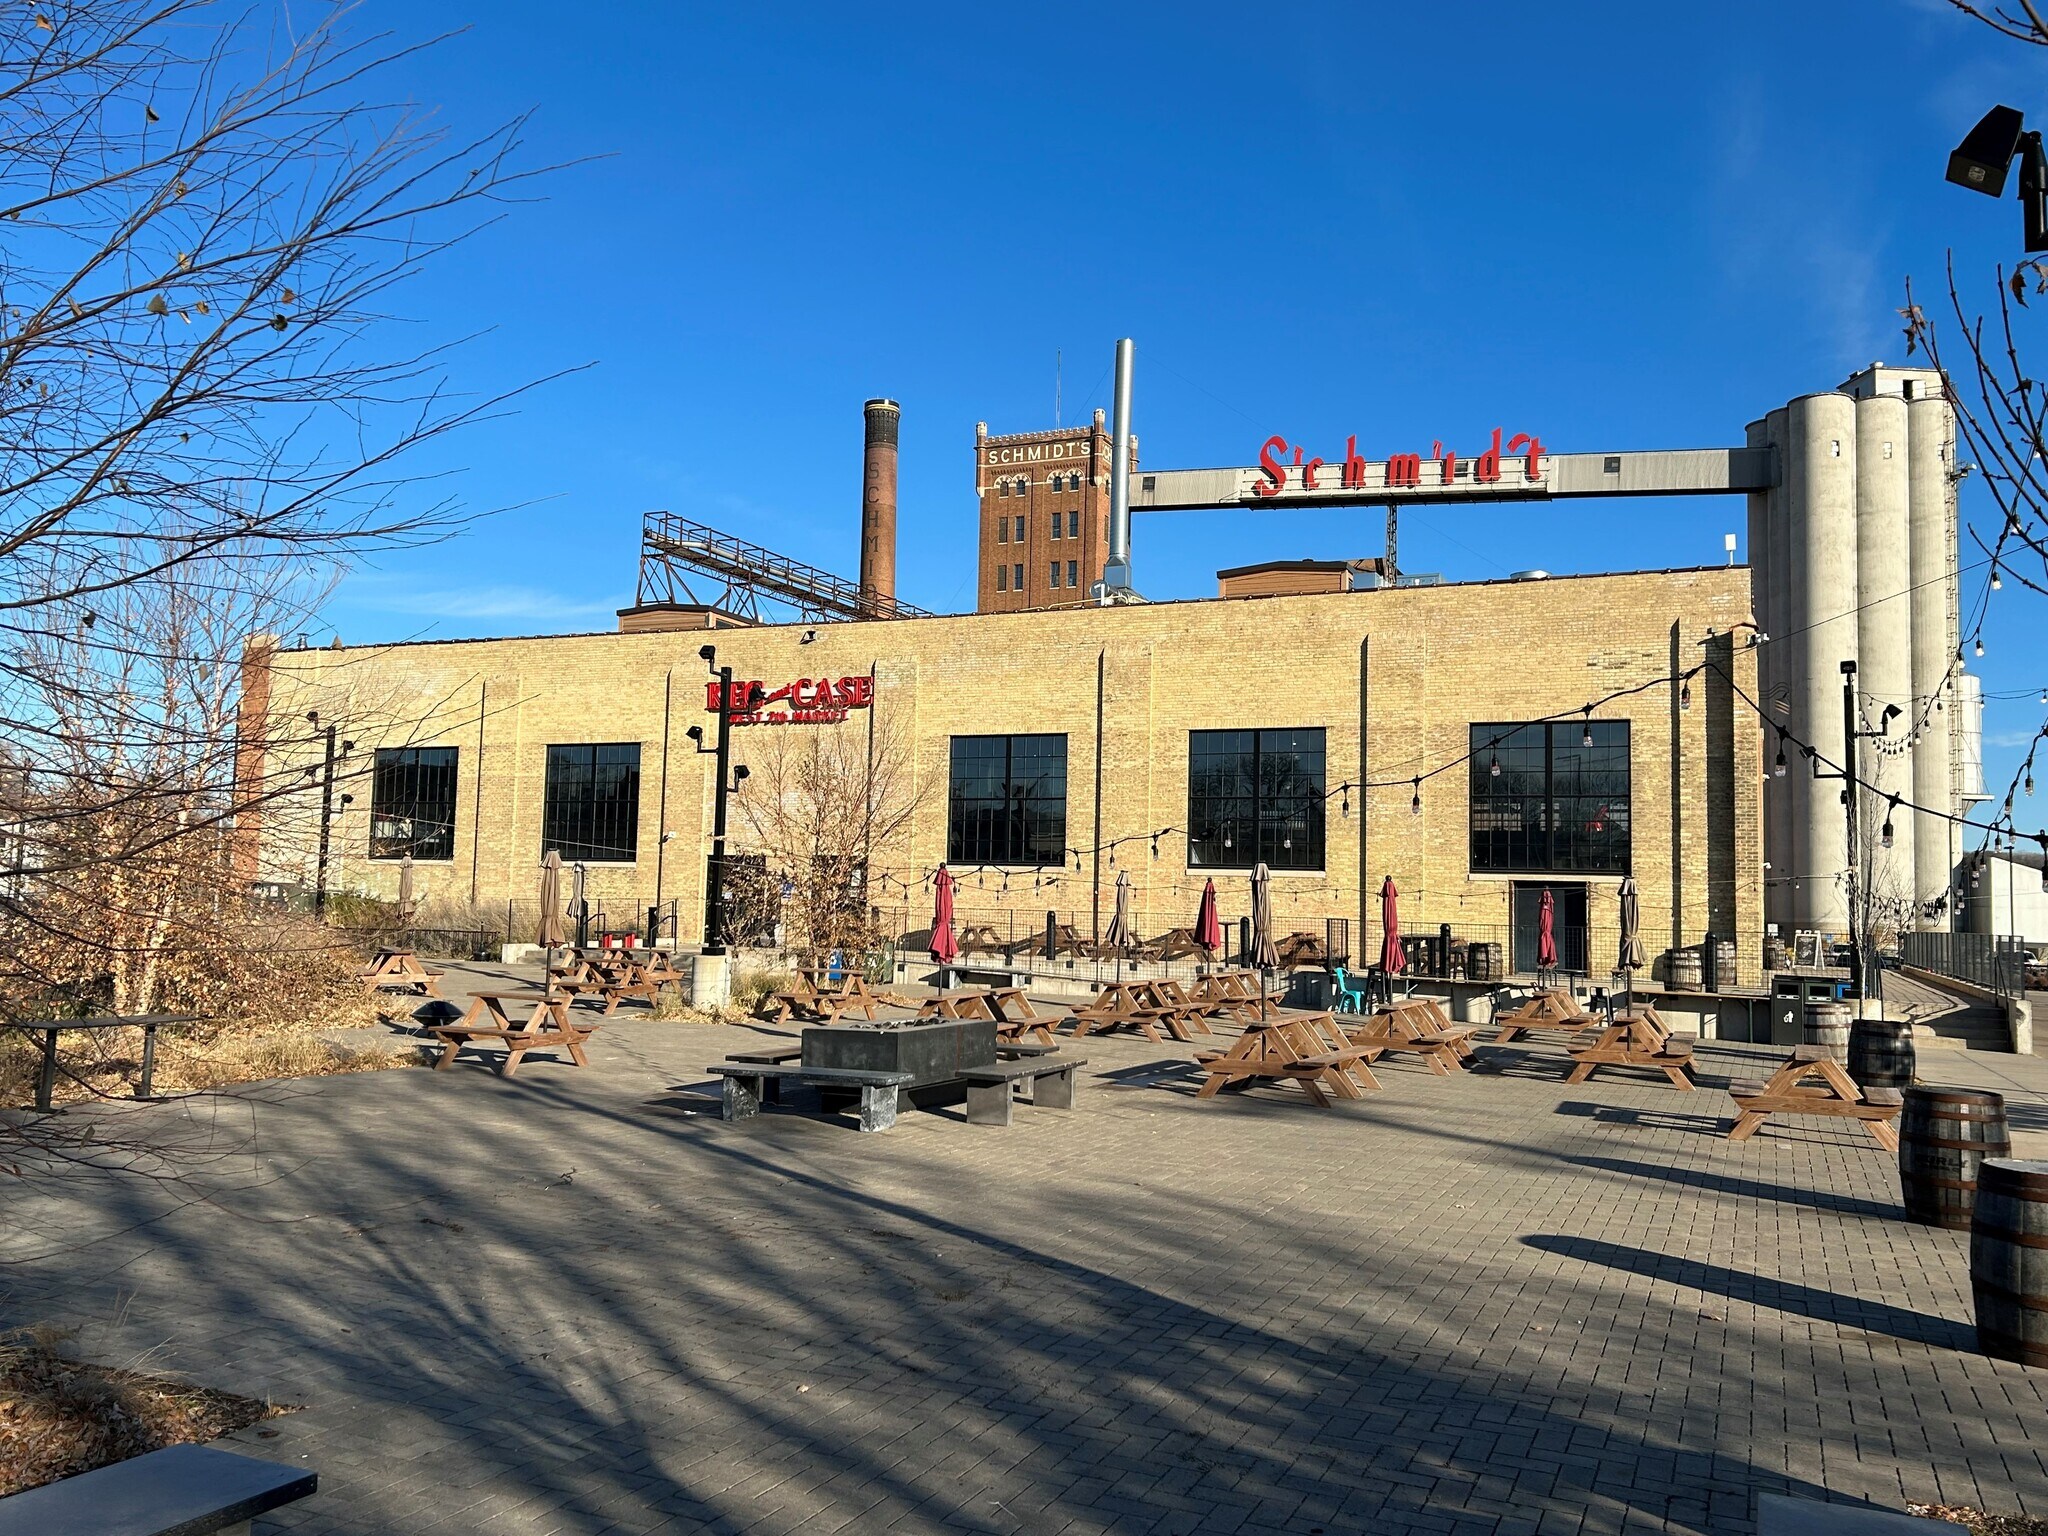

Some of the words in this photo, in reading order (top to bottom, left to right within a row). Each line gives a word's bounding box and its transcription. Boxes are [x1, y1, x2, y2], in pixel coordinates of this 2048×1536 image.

[988, 441, 1091, 464] SCHMIDT'S
[1251, 427, 1547, 496] Schmidt
[865, 461, 880, 612] SCHMID
[792, 676, 873, 706] CASE
[728, 711, 763, 723] WEST
[793, 709, 849, 722] MARKET
